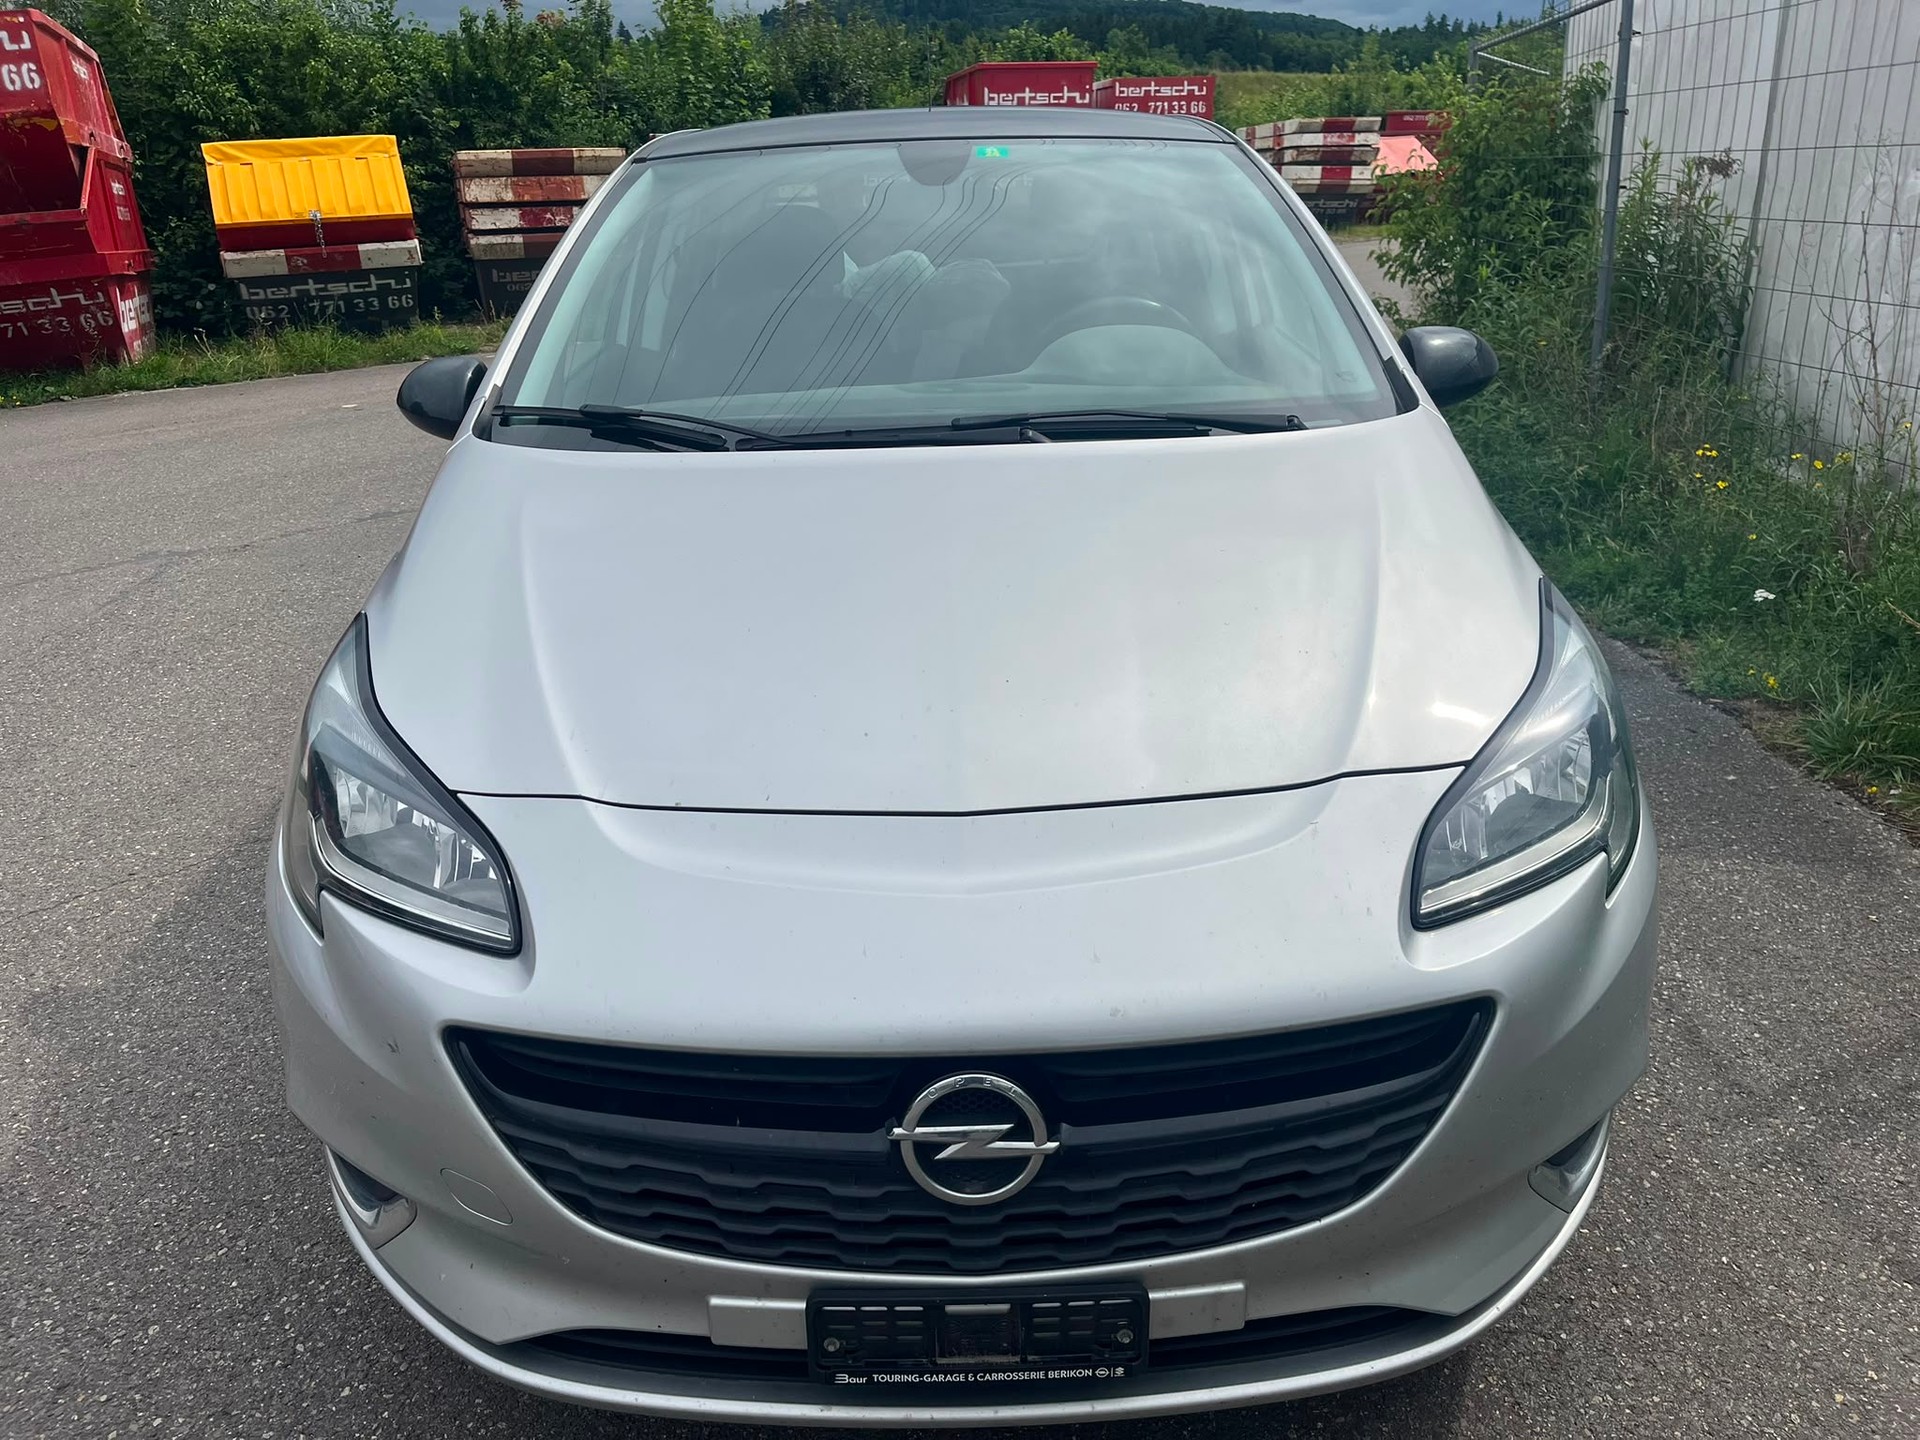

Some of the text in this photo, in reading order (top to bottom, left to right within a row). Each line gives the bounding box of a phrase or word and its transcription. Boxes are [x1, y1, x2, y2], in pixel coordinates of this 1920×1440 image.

[1, 62, 41, 91] 66
[983, 84, 1090, 106] bertschi
[1115, 79, 1207, 97] bertschi
[1148, 101, 1168, 115] 771
[1171, 101, 1187, 114] 33
[1190, 101, 1206, 114] 66
[239, 271, 412, 300] bertschi
[353, 297, 380, 312] 33
[388, 294, 414, 310] 66
[37, 316, 71, 335] 33
[80, 310, 114, 330] 66
[927, 1078, 1017, 1099] OPEL
[834, 1368, 1093, 1384] Baur TOURING-GARAGE & CARROSSERIE BERIKON
